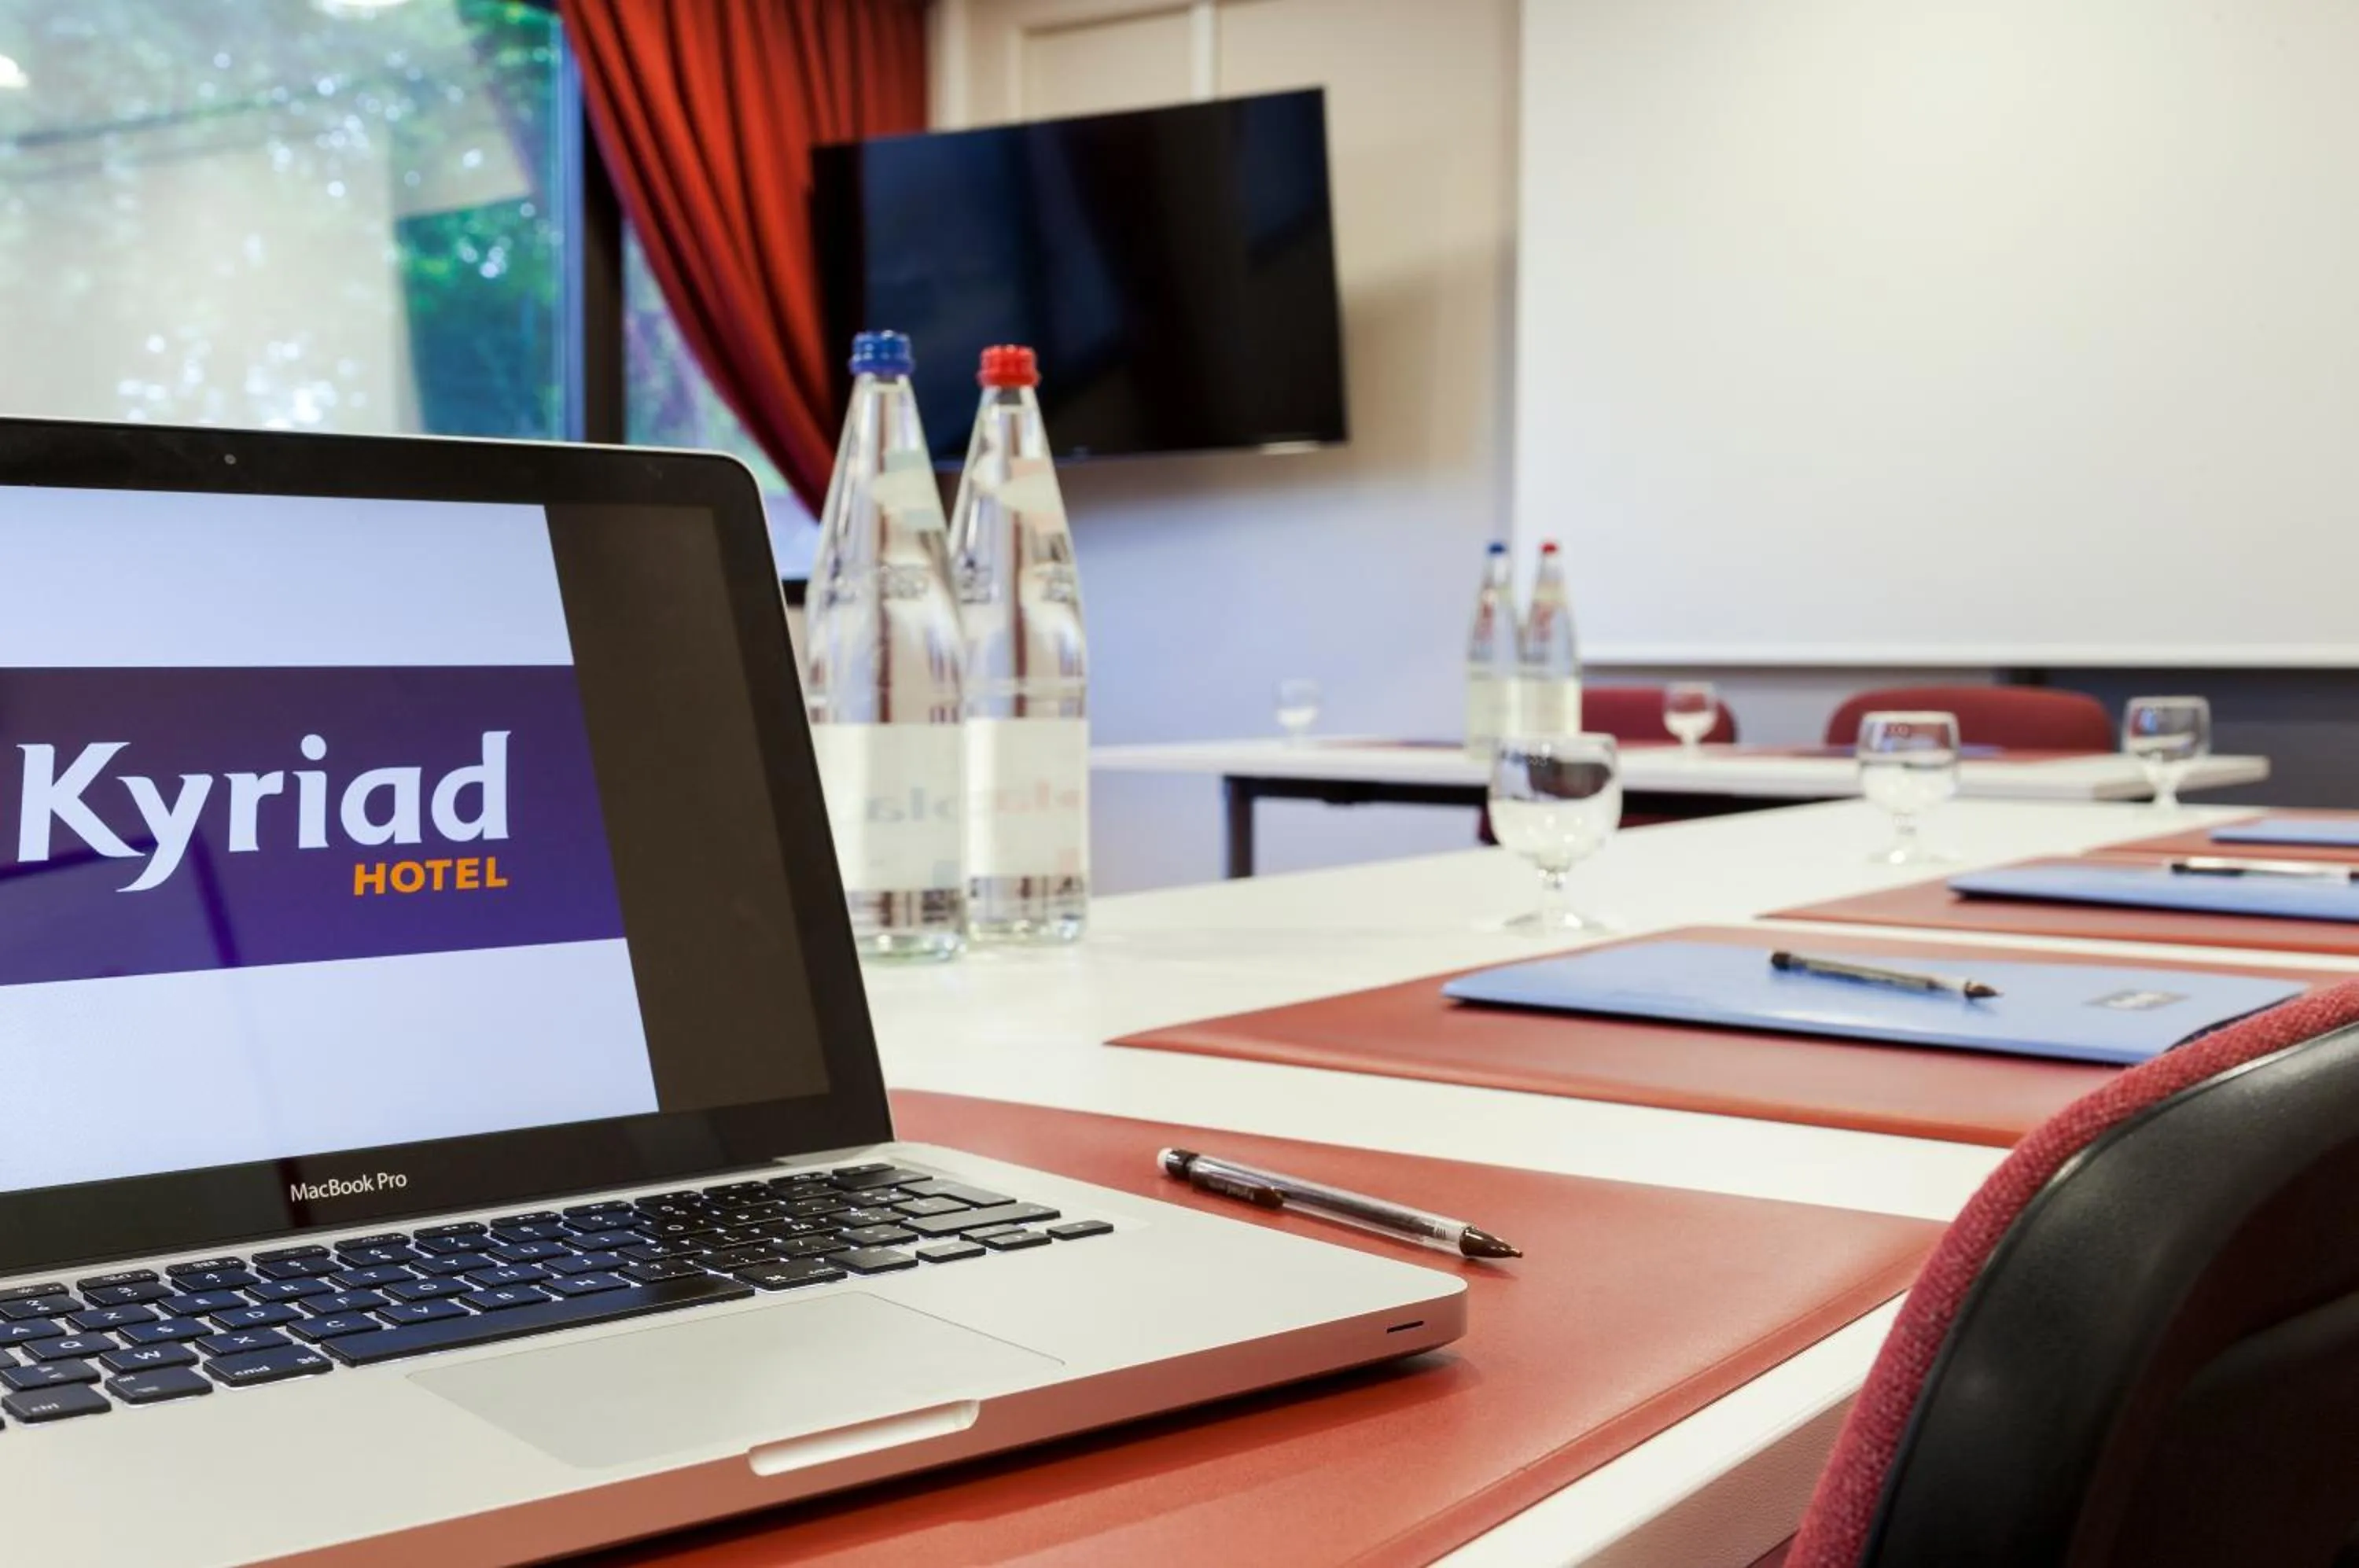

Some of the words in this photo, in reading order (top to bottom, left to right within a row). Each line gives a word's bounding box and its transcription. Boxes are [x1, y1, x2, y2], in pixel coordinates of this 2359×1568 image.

[16, 730, 512, 893] Kyriad
[353, 856, 508, 896] HOTEL
[290, 1174, 374, 1202] MacBook
[377, 1172, 407, 1190] Pro
